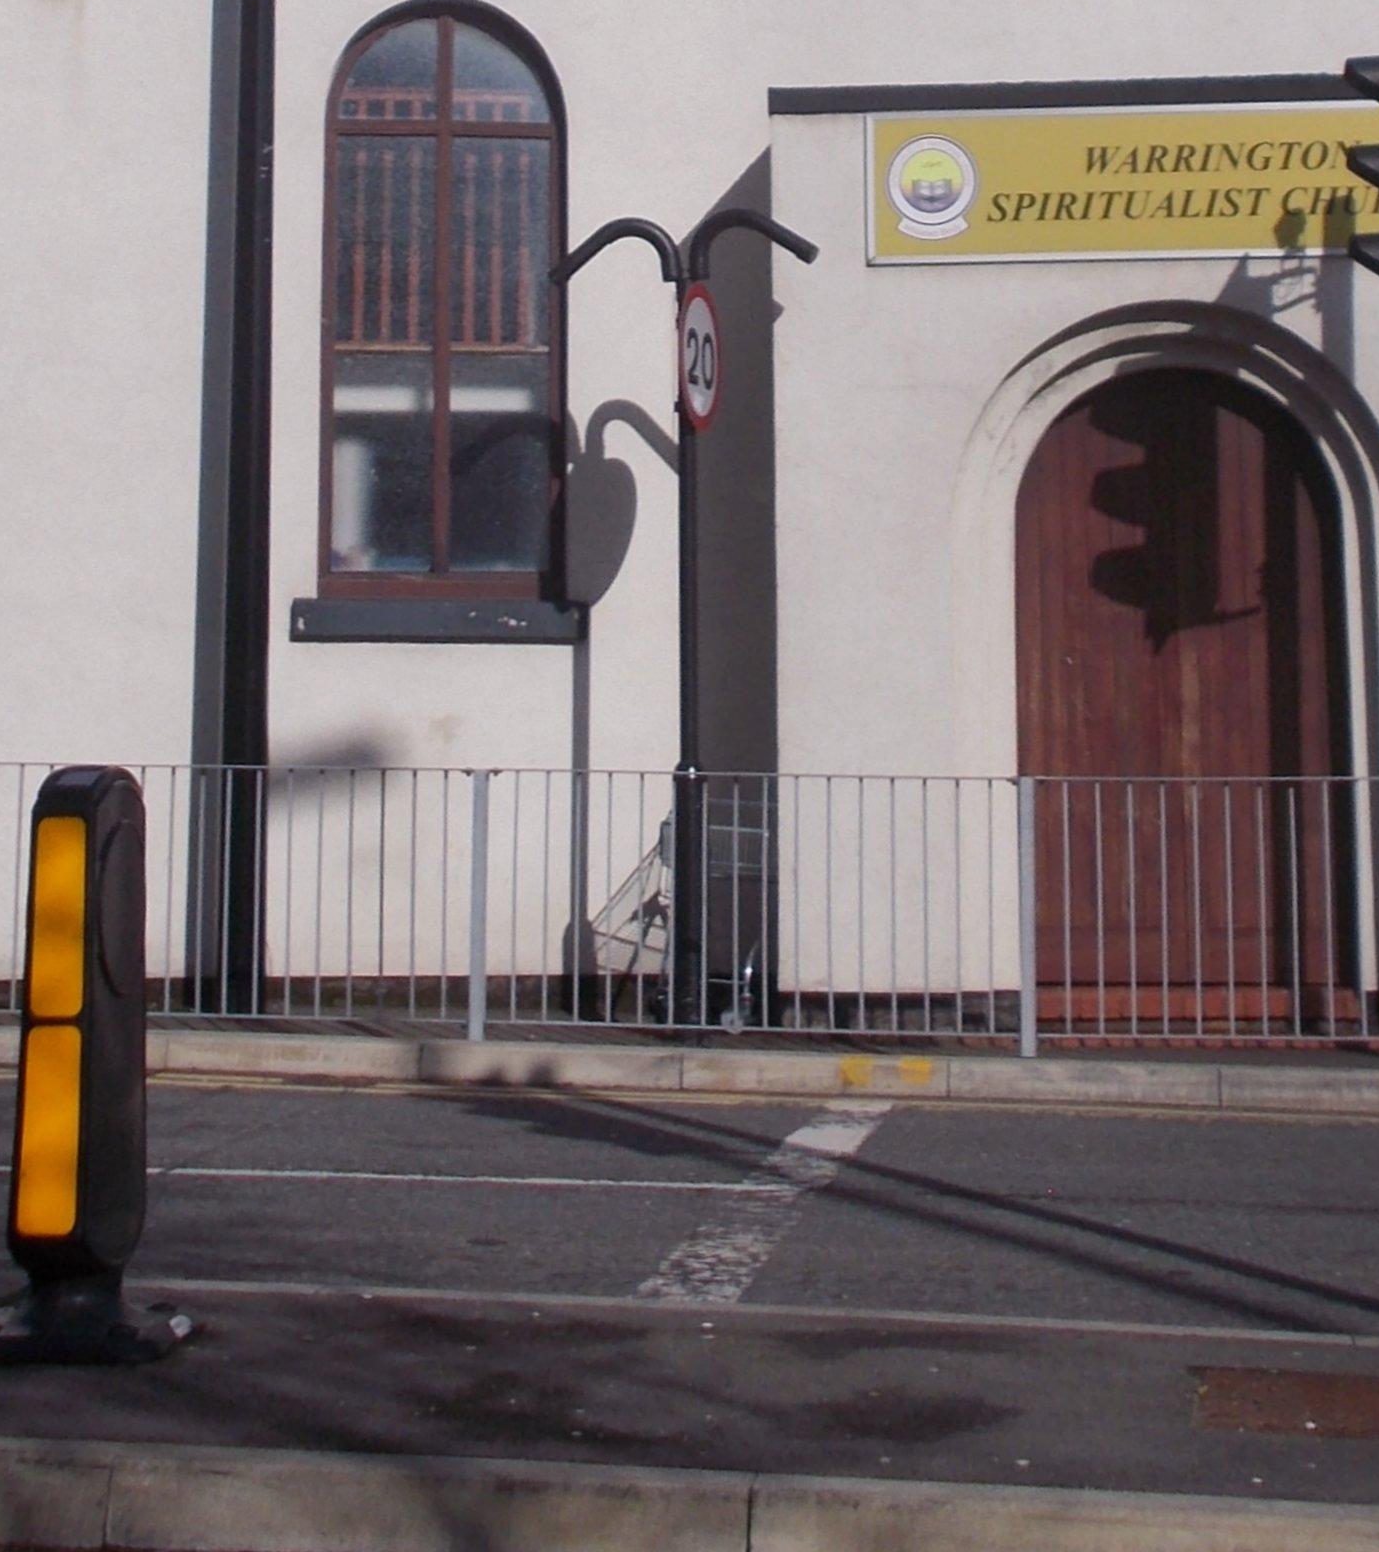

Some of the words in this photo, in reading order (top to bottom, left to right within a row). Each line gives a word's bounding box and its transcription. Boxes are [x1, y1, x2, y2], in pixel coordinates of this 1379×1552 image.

[1084, 138, 1361, 176] WARRINGTON
[986, 186, 1270, 223] SPIRITUALIST
[686, 326, 715, 391] 20
